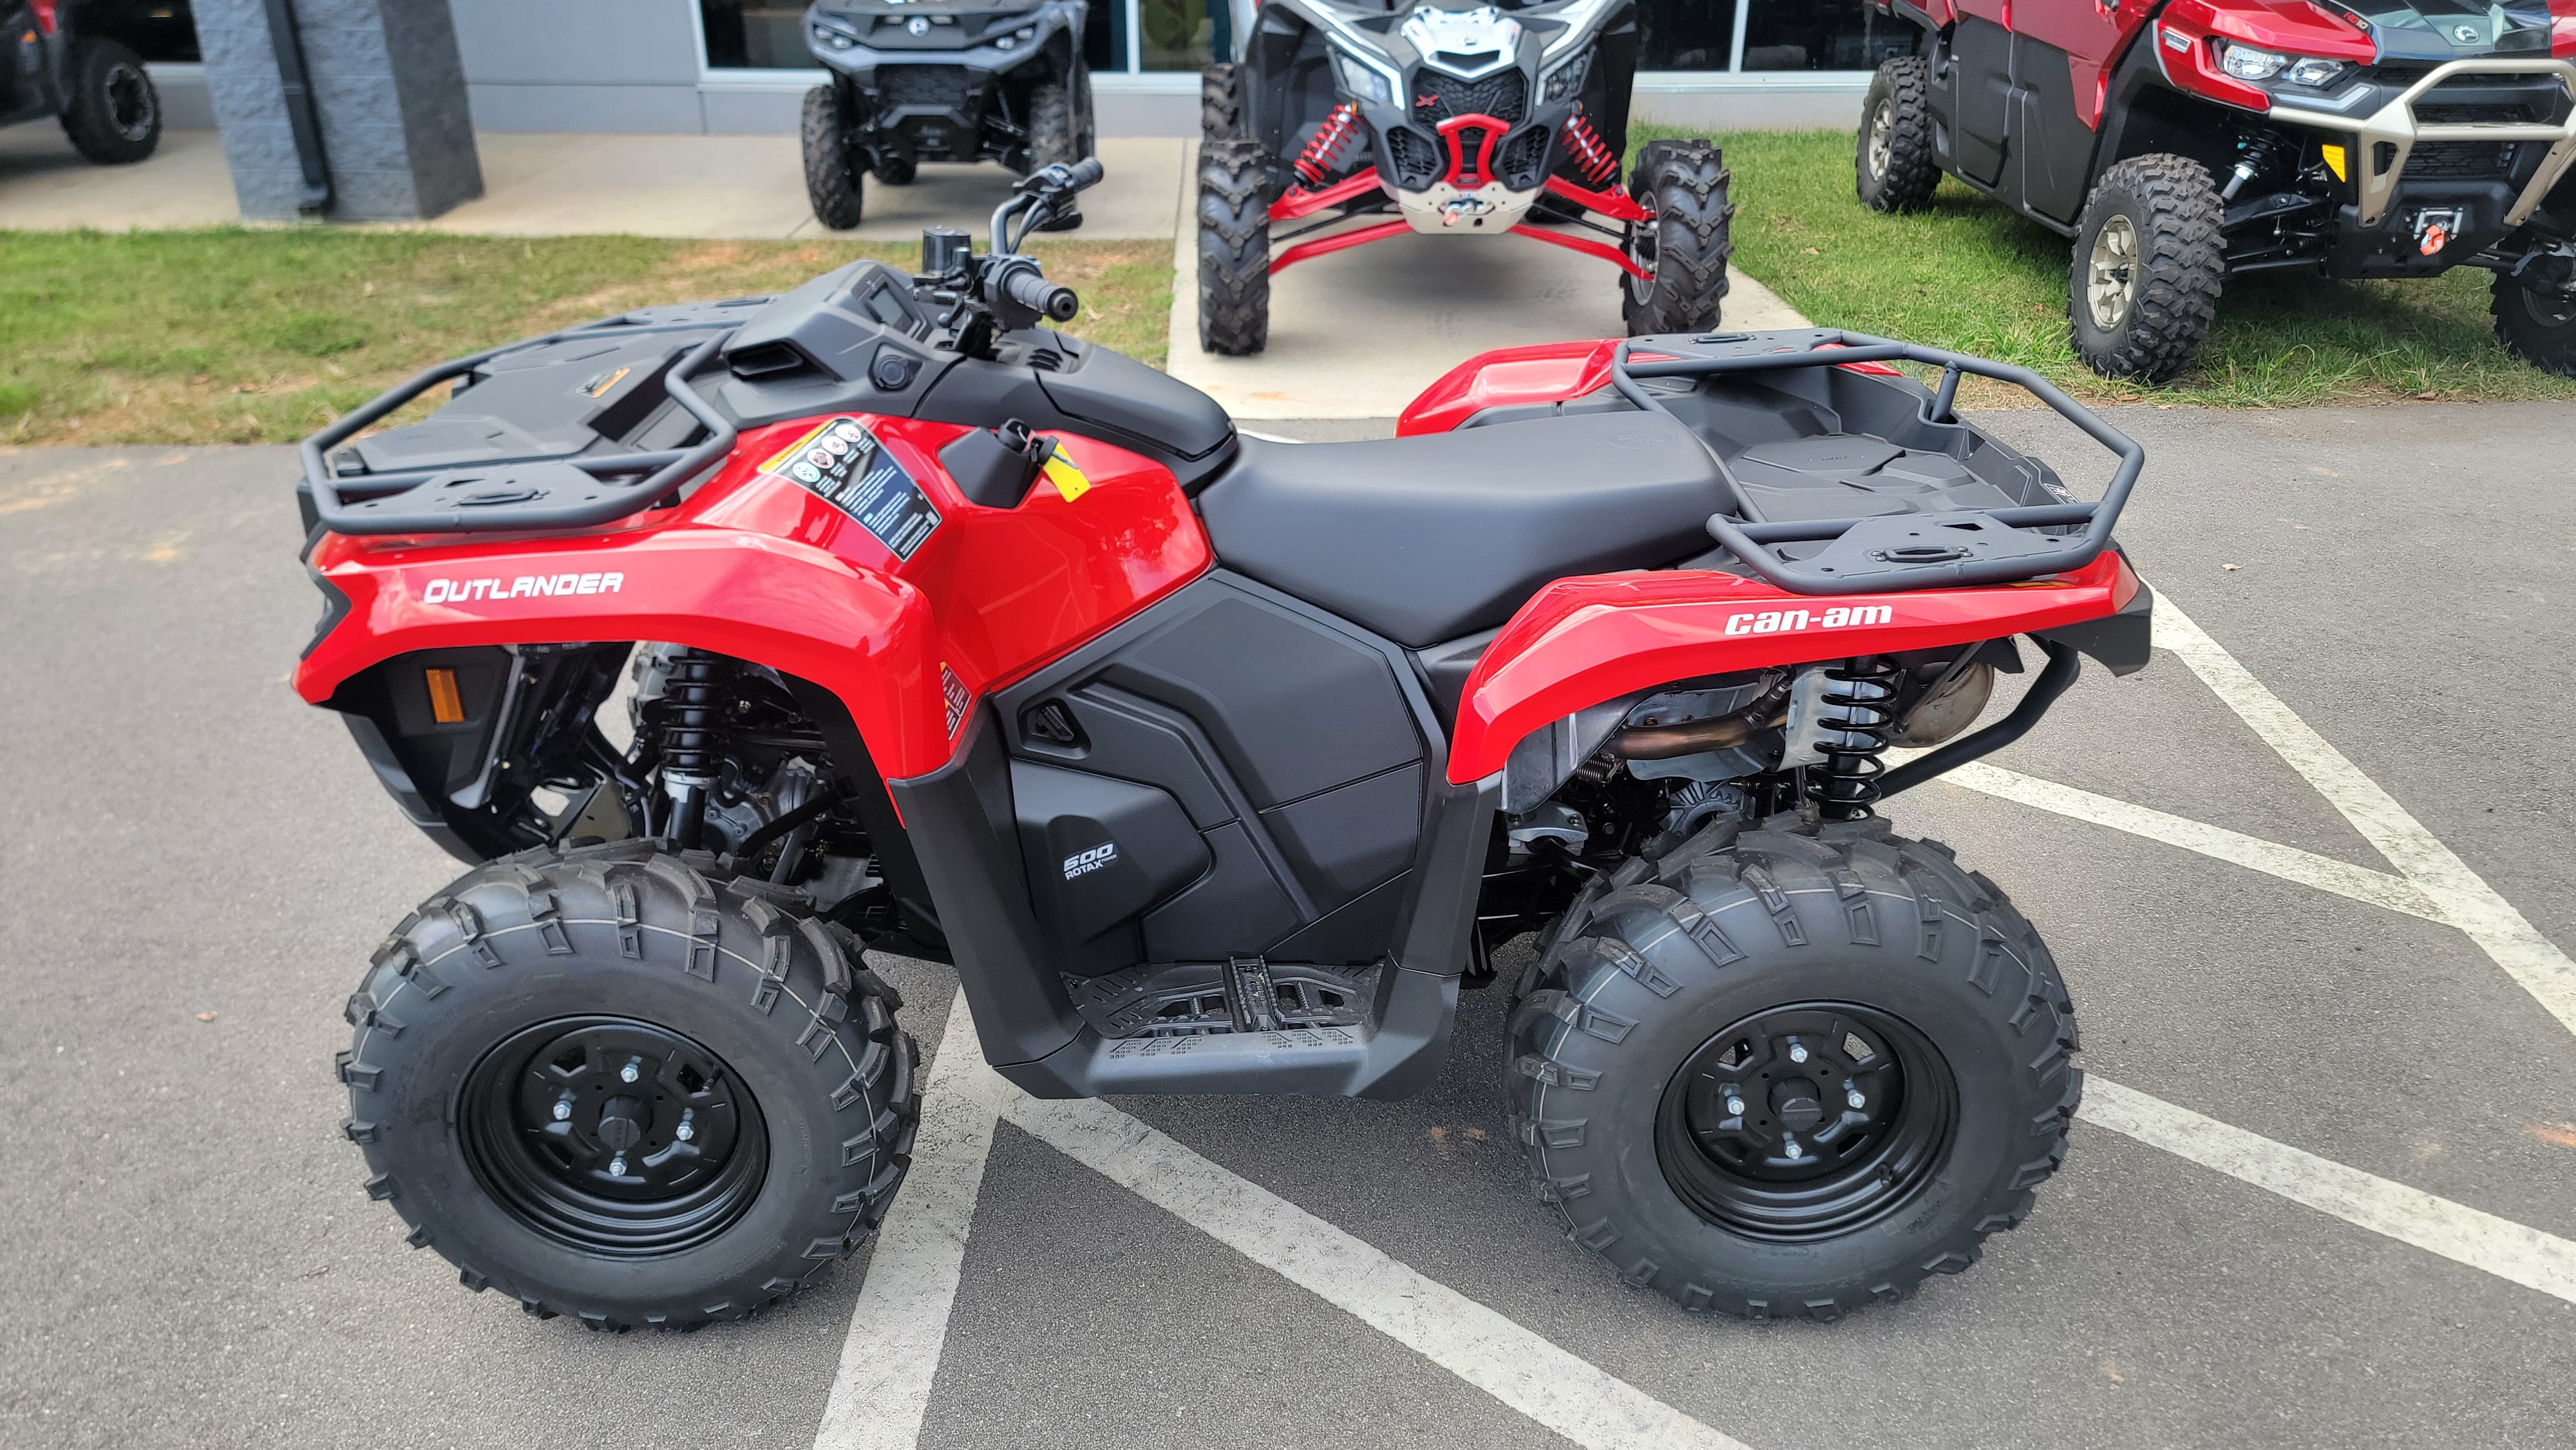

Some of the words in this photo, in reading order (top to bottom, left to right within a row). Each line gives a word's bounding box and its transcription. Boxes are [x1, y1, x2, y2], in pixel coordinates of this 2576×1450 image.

[424, 572, 624, 604] OUTLANDER
[1725, 605, 1893, 636] can-am
[1064, 843, 1113, 872] 500
[1065, 859, 1103, 880] ROTAX
[1101, 854, 1117, 863] POWER
